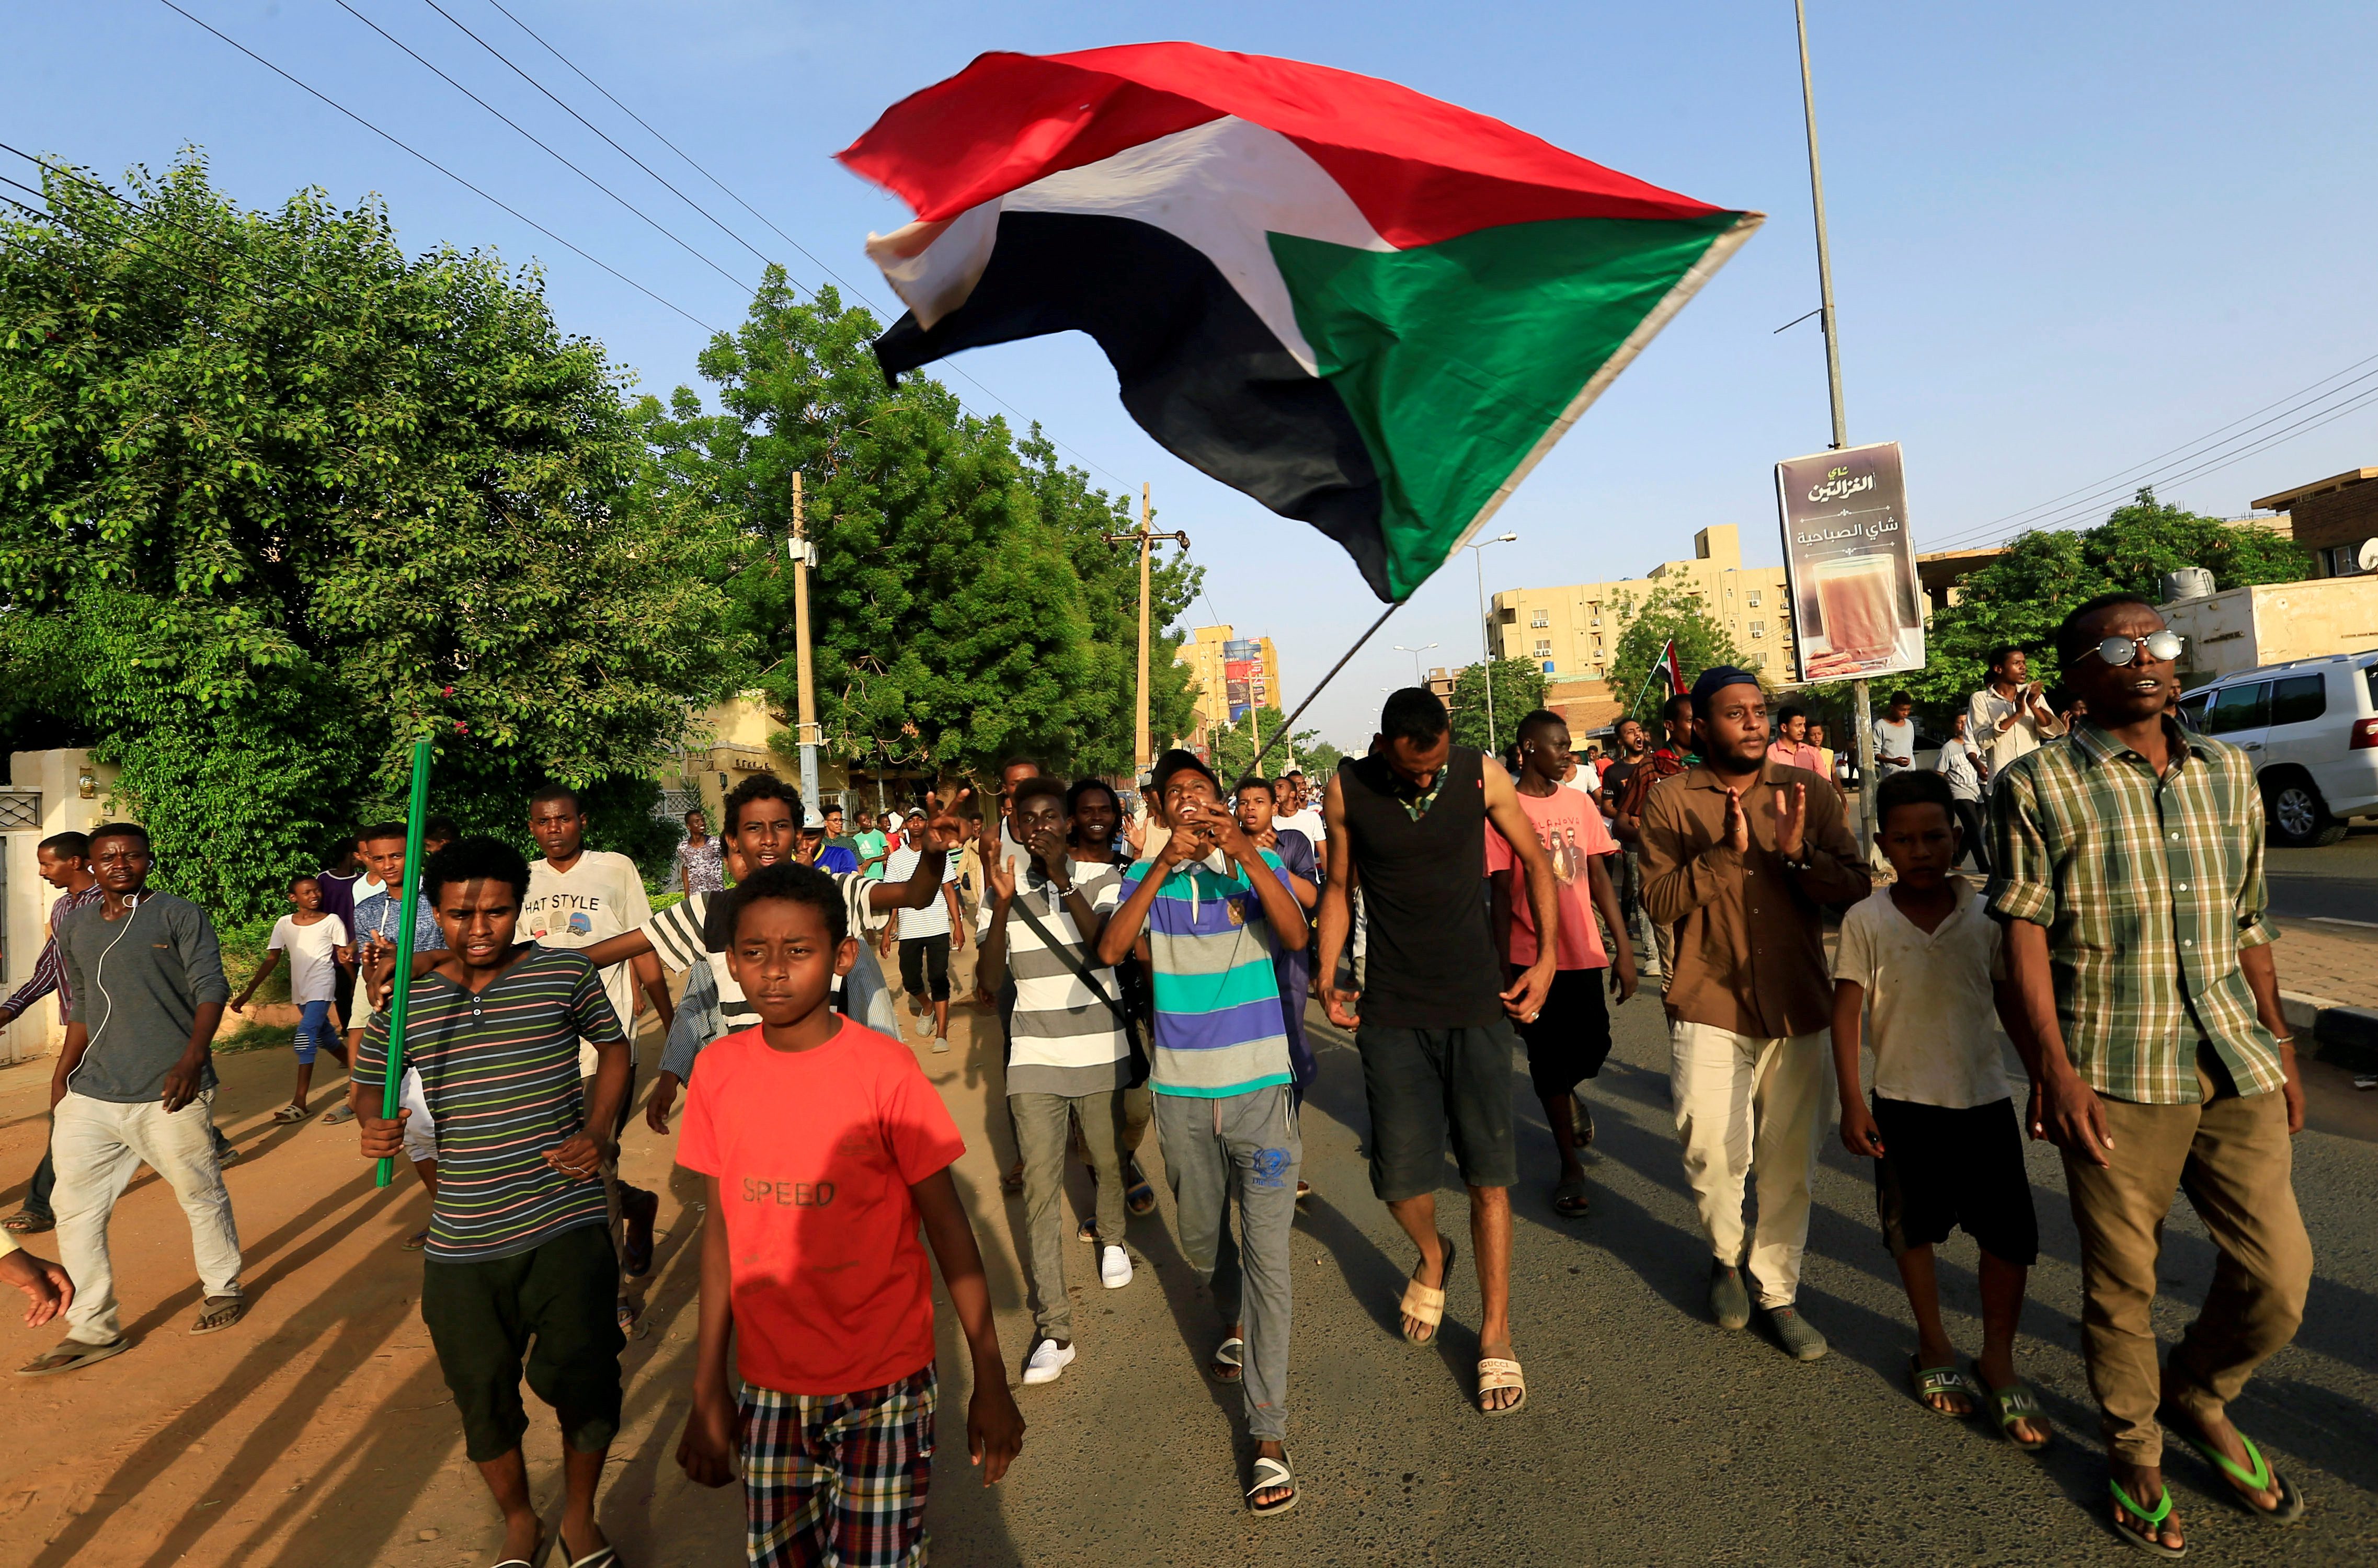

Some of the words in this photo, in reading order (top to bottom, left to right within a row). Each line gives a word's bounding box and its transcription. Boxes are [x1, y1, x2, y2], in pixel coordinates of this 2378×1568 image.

[1828, 466, 1848, 480] شاي
[1808, 475, 1873, 502] الغزالتين
[1797, 523, 1862, 546] الصباحية
[1865, 517, 1899, 540] شاي
[525, 897, 547, 915] HAT
[552, 895, 599, 911] STYLE
[742, 1177, 835, 1207] SPEED
[1925, 1373, 1962, 1388] FILA
